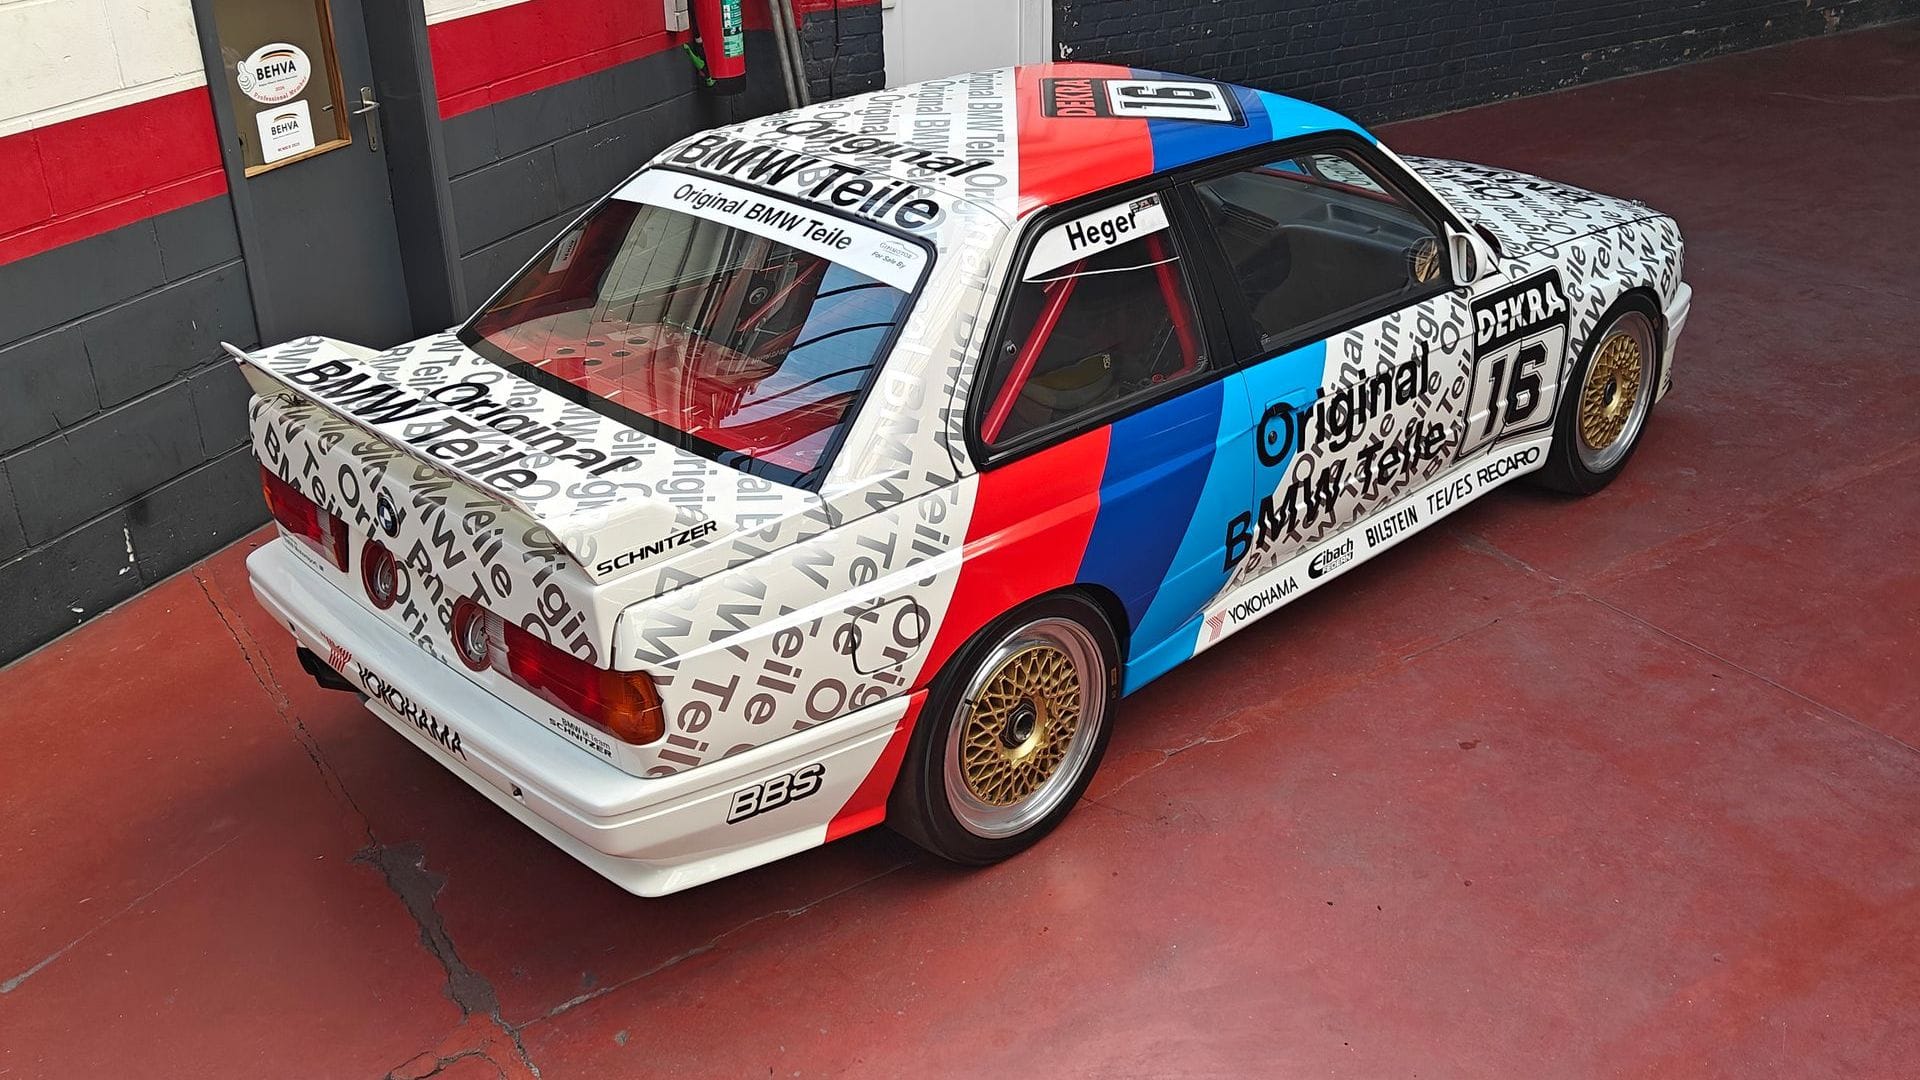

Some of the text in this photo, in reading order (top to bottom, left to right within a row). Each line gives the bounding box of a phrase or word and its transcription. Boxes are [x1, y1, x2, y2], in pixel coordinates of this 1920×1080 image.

[256, 60, 297, 81] BEHVA
[908, 80, 956, 115] Original
[1054, 79, 1097, 117] DEKRA
[1115, 85, 1221, 112] 16
[270, 120, 299, 136] BEHVA
[966, 103, 1003, 132] BMW
[776, 120, 993, 177] Original
[673, 135, 822, 188] BMW
[810, 163, 941, 229] Teile
[673, 183, 853, 251] Original BMW Teile
[1066, 210, 1137, 252] Heger
[1476, 281, 1567, 347] DEKRA
[1257, 340, 1429, 468] Original
[1480, 340, 1549, 440] 16
[284, 359, 440, 426] BMW
[405, 415, 538, 492] Teile
[428, 383, 640, 477] Original
[1223, 457, 1348, 575] BMW
[1357, 420, 1446, 495] Teile
[596, 520, 718, 577] SCHNITZER
[1228, 575, 1299, 625] YOKOHAMA
[1308, 537, 1354, 580] Eibach
[1365, 504, 1419, 549] BILSTEIN
[1427, 474, 1474, 515] TEVES
[1477, 446, 1541, 487] RECARO
[356, 661, 468, 762] YOKOHAMA
[549, 717, 613, 759] SCHNITZER
[561, 717, 582, 735] BMW
[726, 763, 826, 825] BBS
